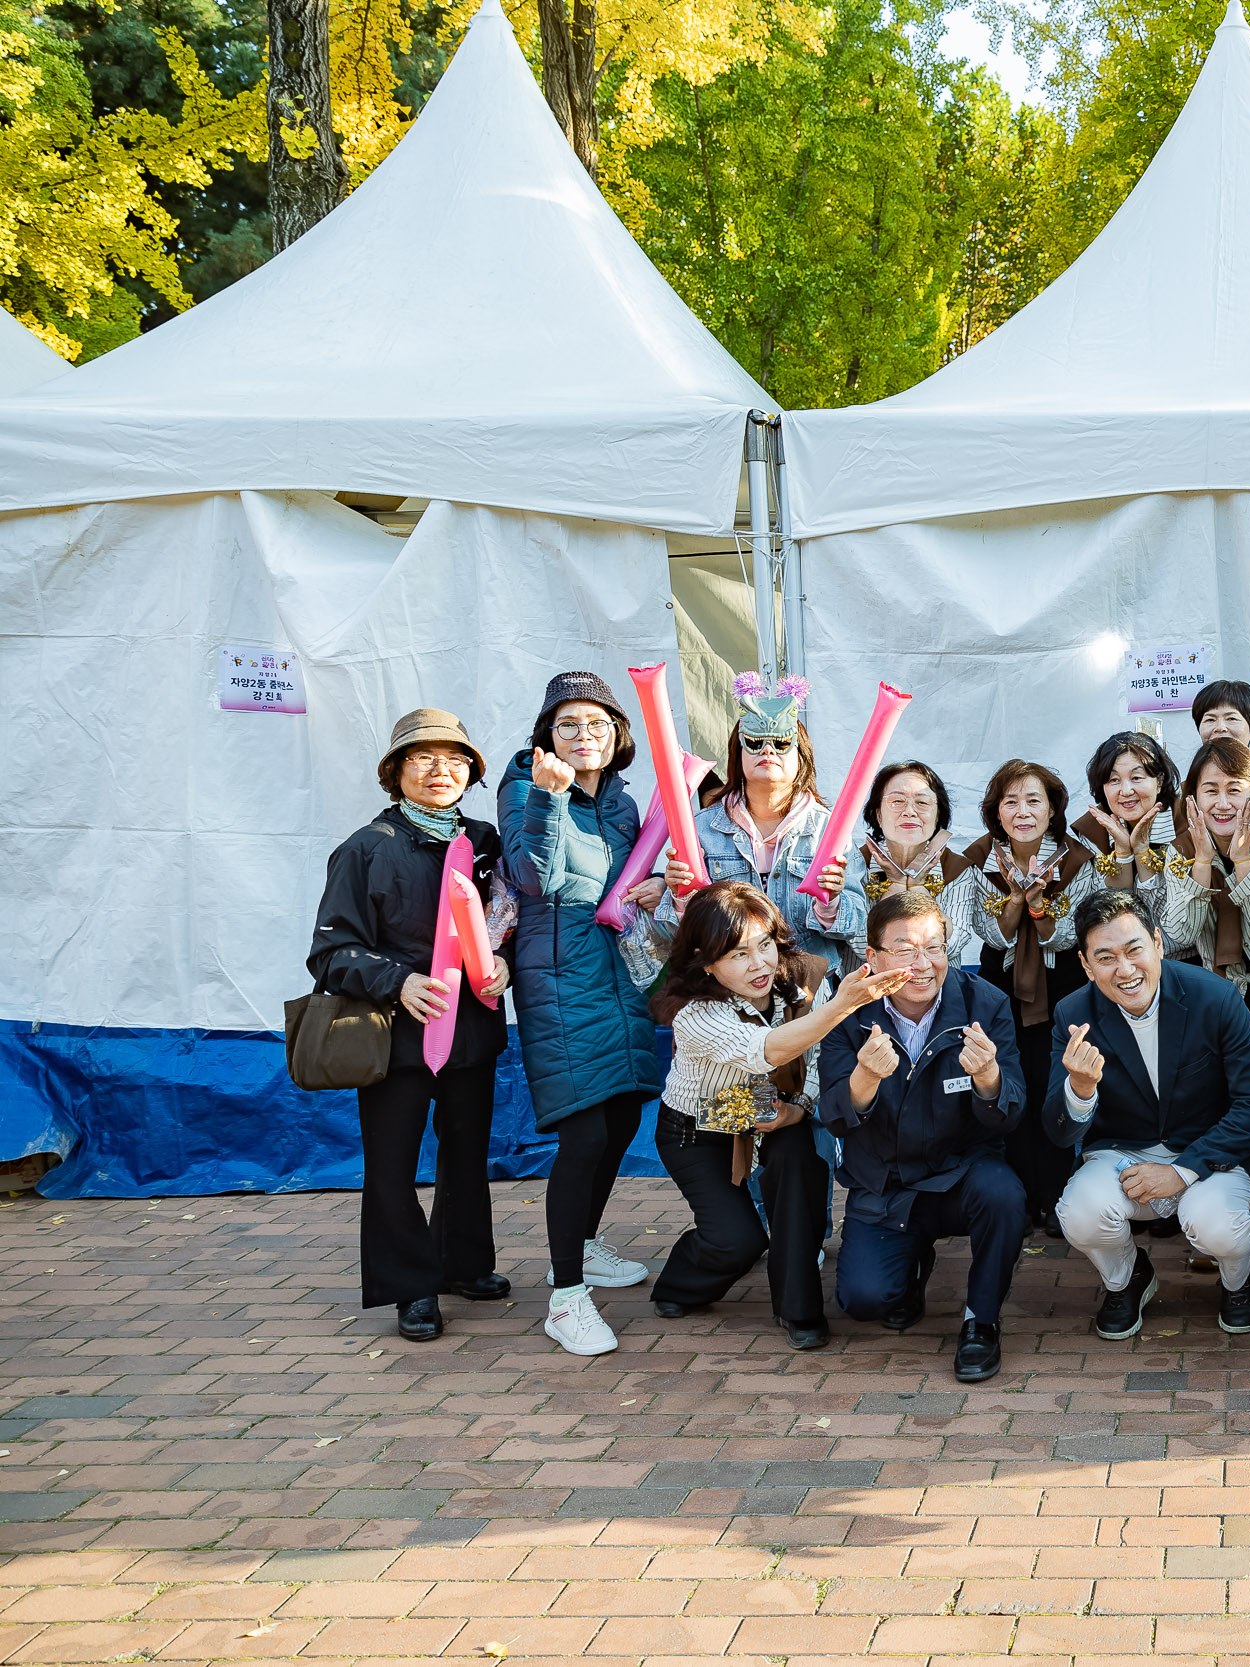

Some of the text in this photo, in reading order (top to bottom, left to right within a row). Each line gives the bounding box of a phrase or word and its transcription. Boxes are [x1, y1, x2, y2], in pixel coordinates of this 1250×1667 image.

[230, 677, 267, 689] 자양2동
[1131, 674, 1205, 689] 자양3동 라인댄스팀
